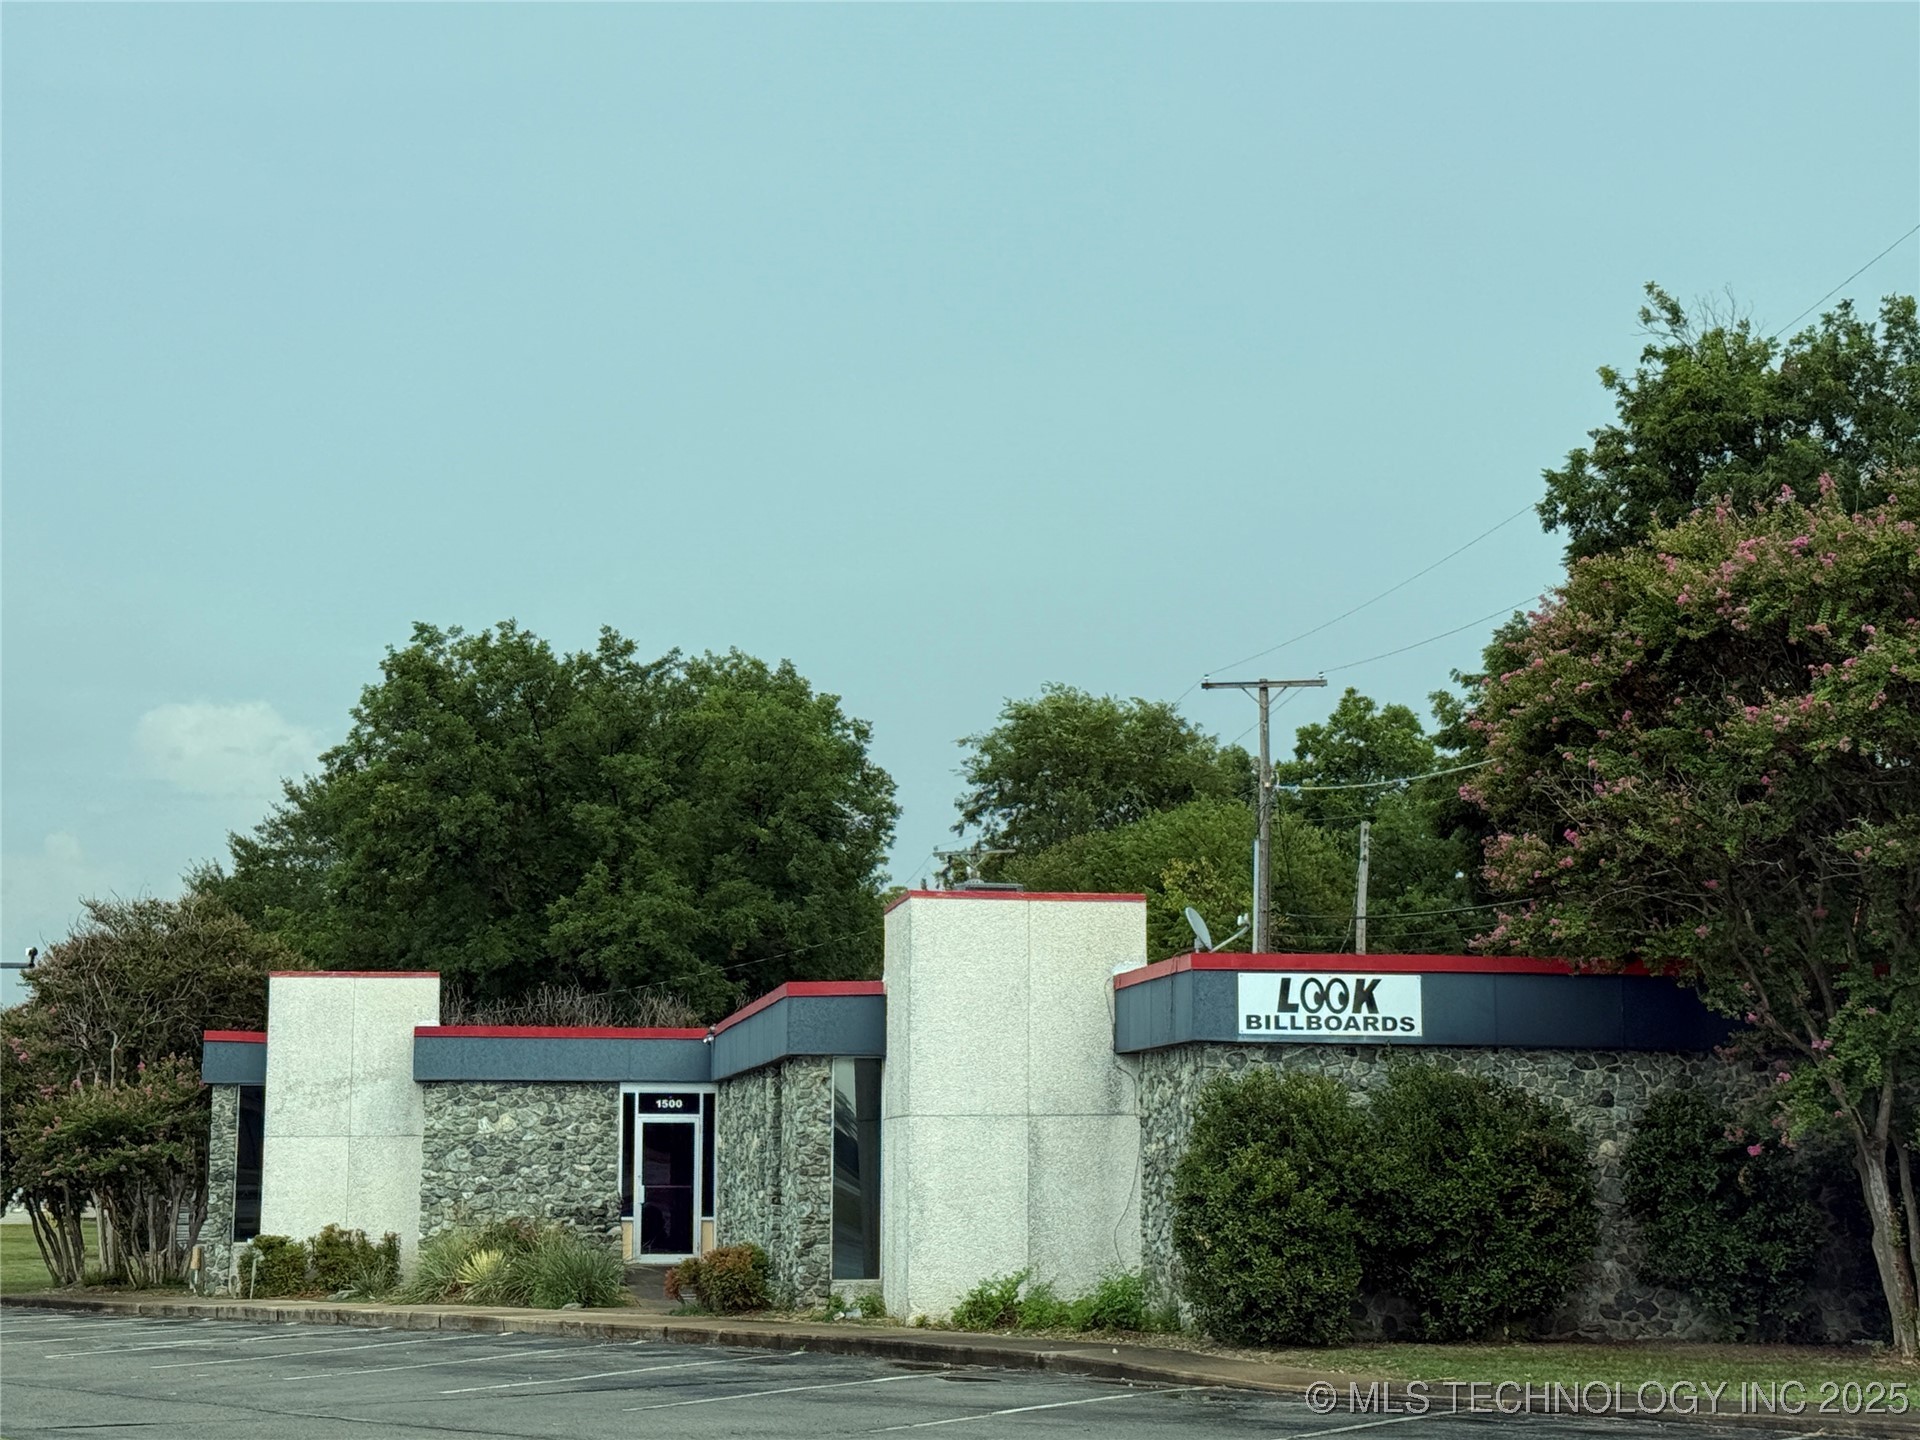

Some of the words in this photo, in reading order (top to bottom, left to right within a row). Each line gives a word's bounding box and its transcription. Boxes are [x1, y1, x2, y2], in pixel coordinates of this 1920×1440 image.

[1277, 977, 1381, 1014] LOOK
[1246, 1014, 1415, 1032] BILLBOARDS
[655, 1098, 683, 1109] 1500
